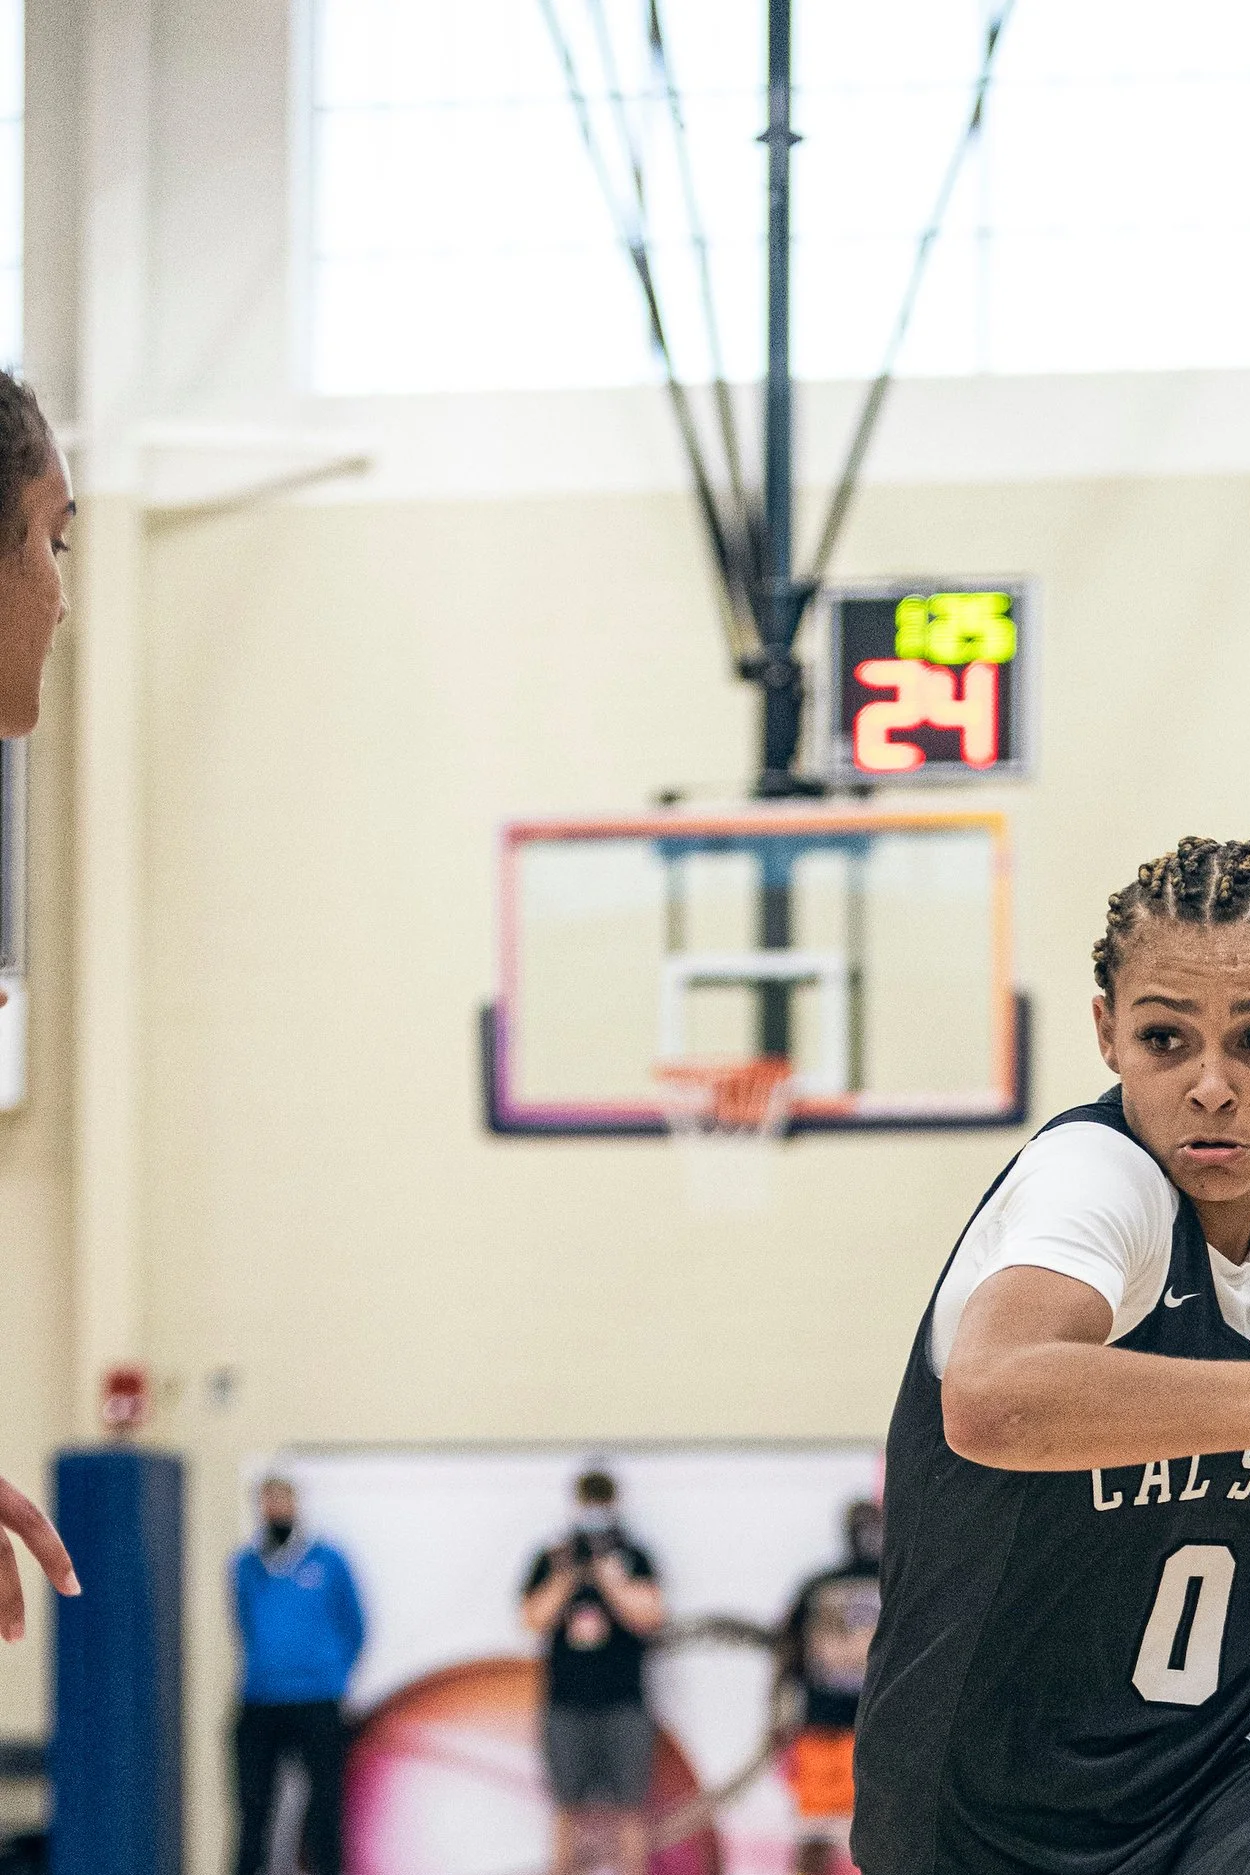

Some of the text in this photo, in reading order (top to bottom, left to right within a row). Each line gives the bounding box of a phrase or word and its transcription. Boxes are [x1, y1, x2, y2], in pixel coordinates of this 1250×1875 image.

[853, 660, 998, 774] 24
[1091, 1454, 1210, 1512] CAL
[1131, 1544, 1236, 1706] 0
